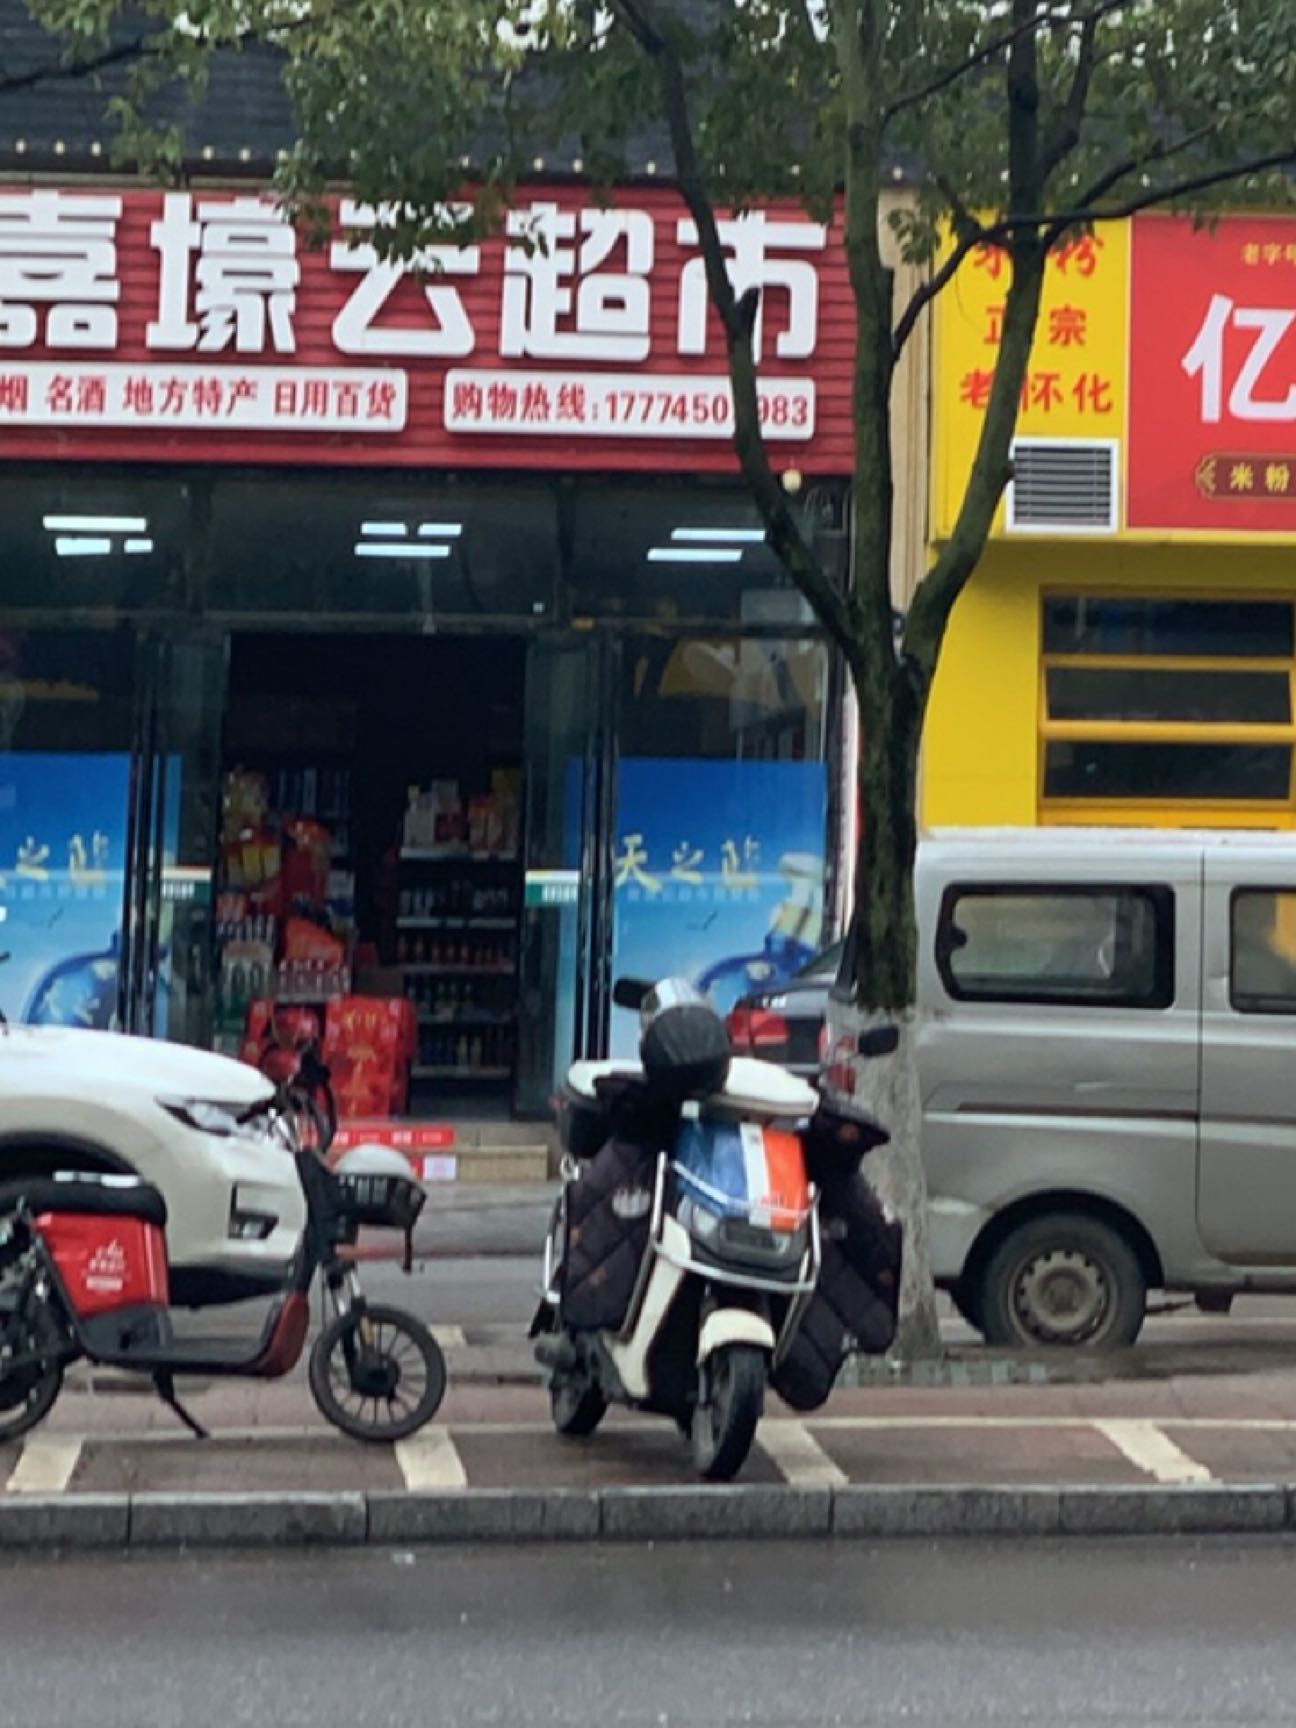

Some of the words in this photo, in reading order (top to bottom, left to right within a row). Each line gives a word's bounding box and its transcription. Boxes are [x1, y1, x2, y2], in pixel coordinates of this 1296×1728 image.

[46, 375, 107, 415] 名酒
[122, 377, 259, 418] 地方特产
[273, 380, 398, 420] 日用百货
[452, 382, 808, 426] 购物热线:1777450983
[1229, 462, 1291, 492] 米粉
